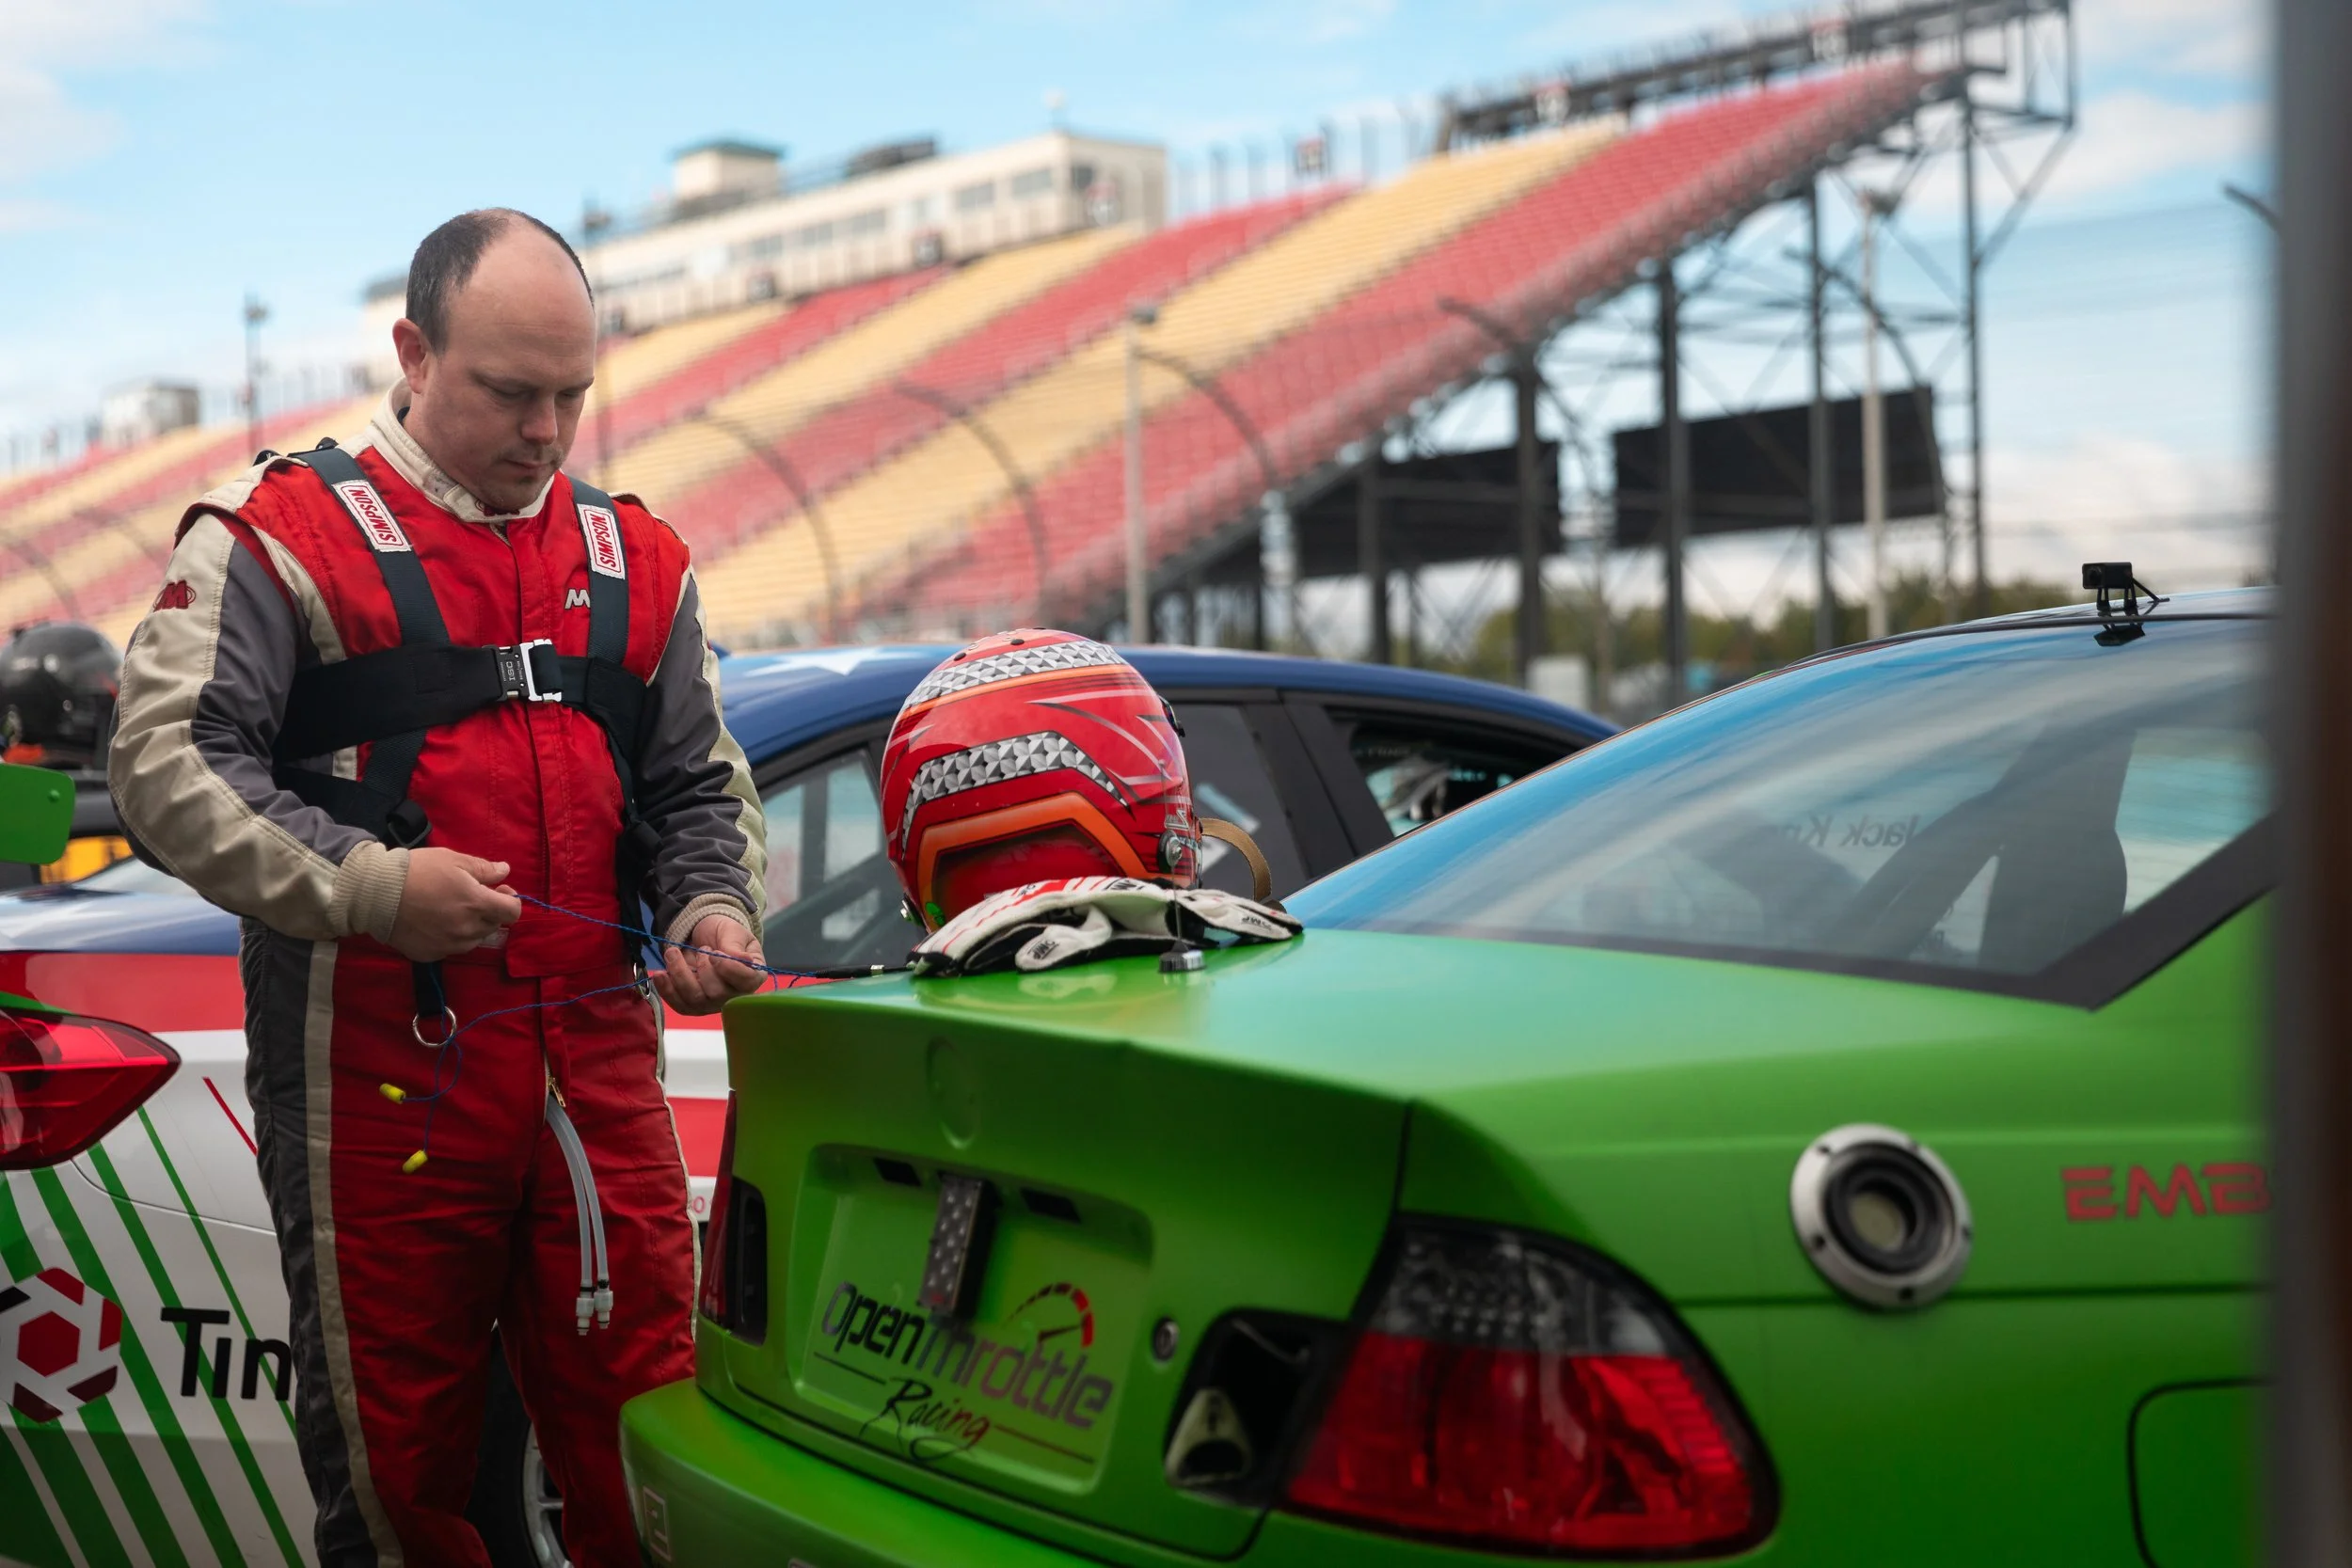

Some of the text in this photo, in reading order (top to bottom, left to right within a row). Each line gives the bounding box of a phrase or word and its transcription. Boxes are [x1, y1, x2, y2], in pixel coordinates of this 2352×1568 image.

[347, 488, 397, 543] SIMPSON
[589, 513, 617, 568] SIMPSON
[859, 1376, 991, 1462] Racing
